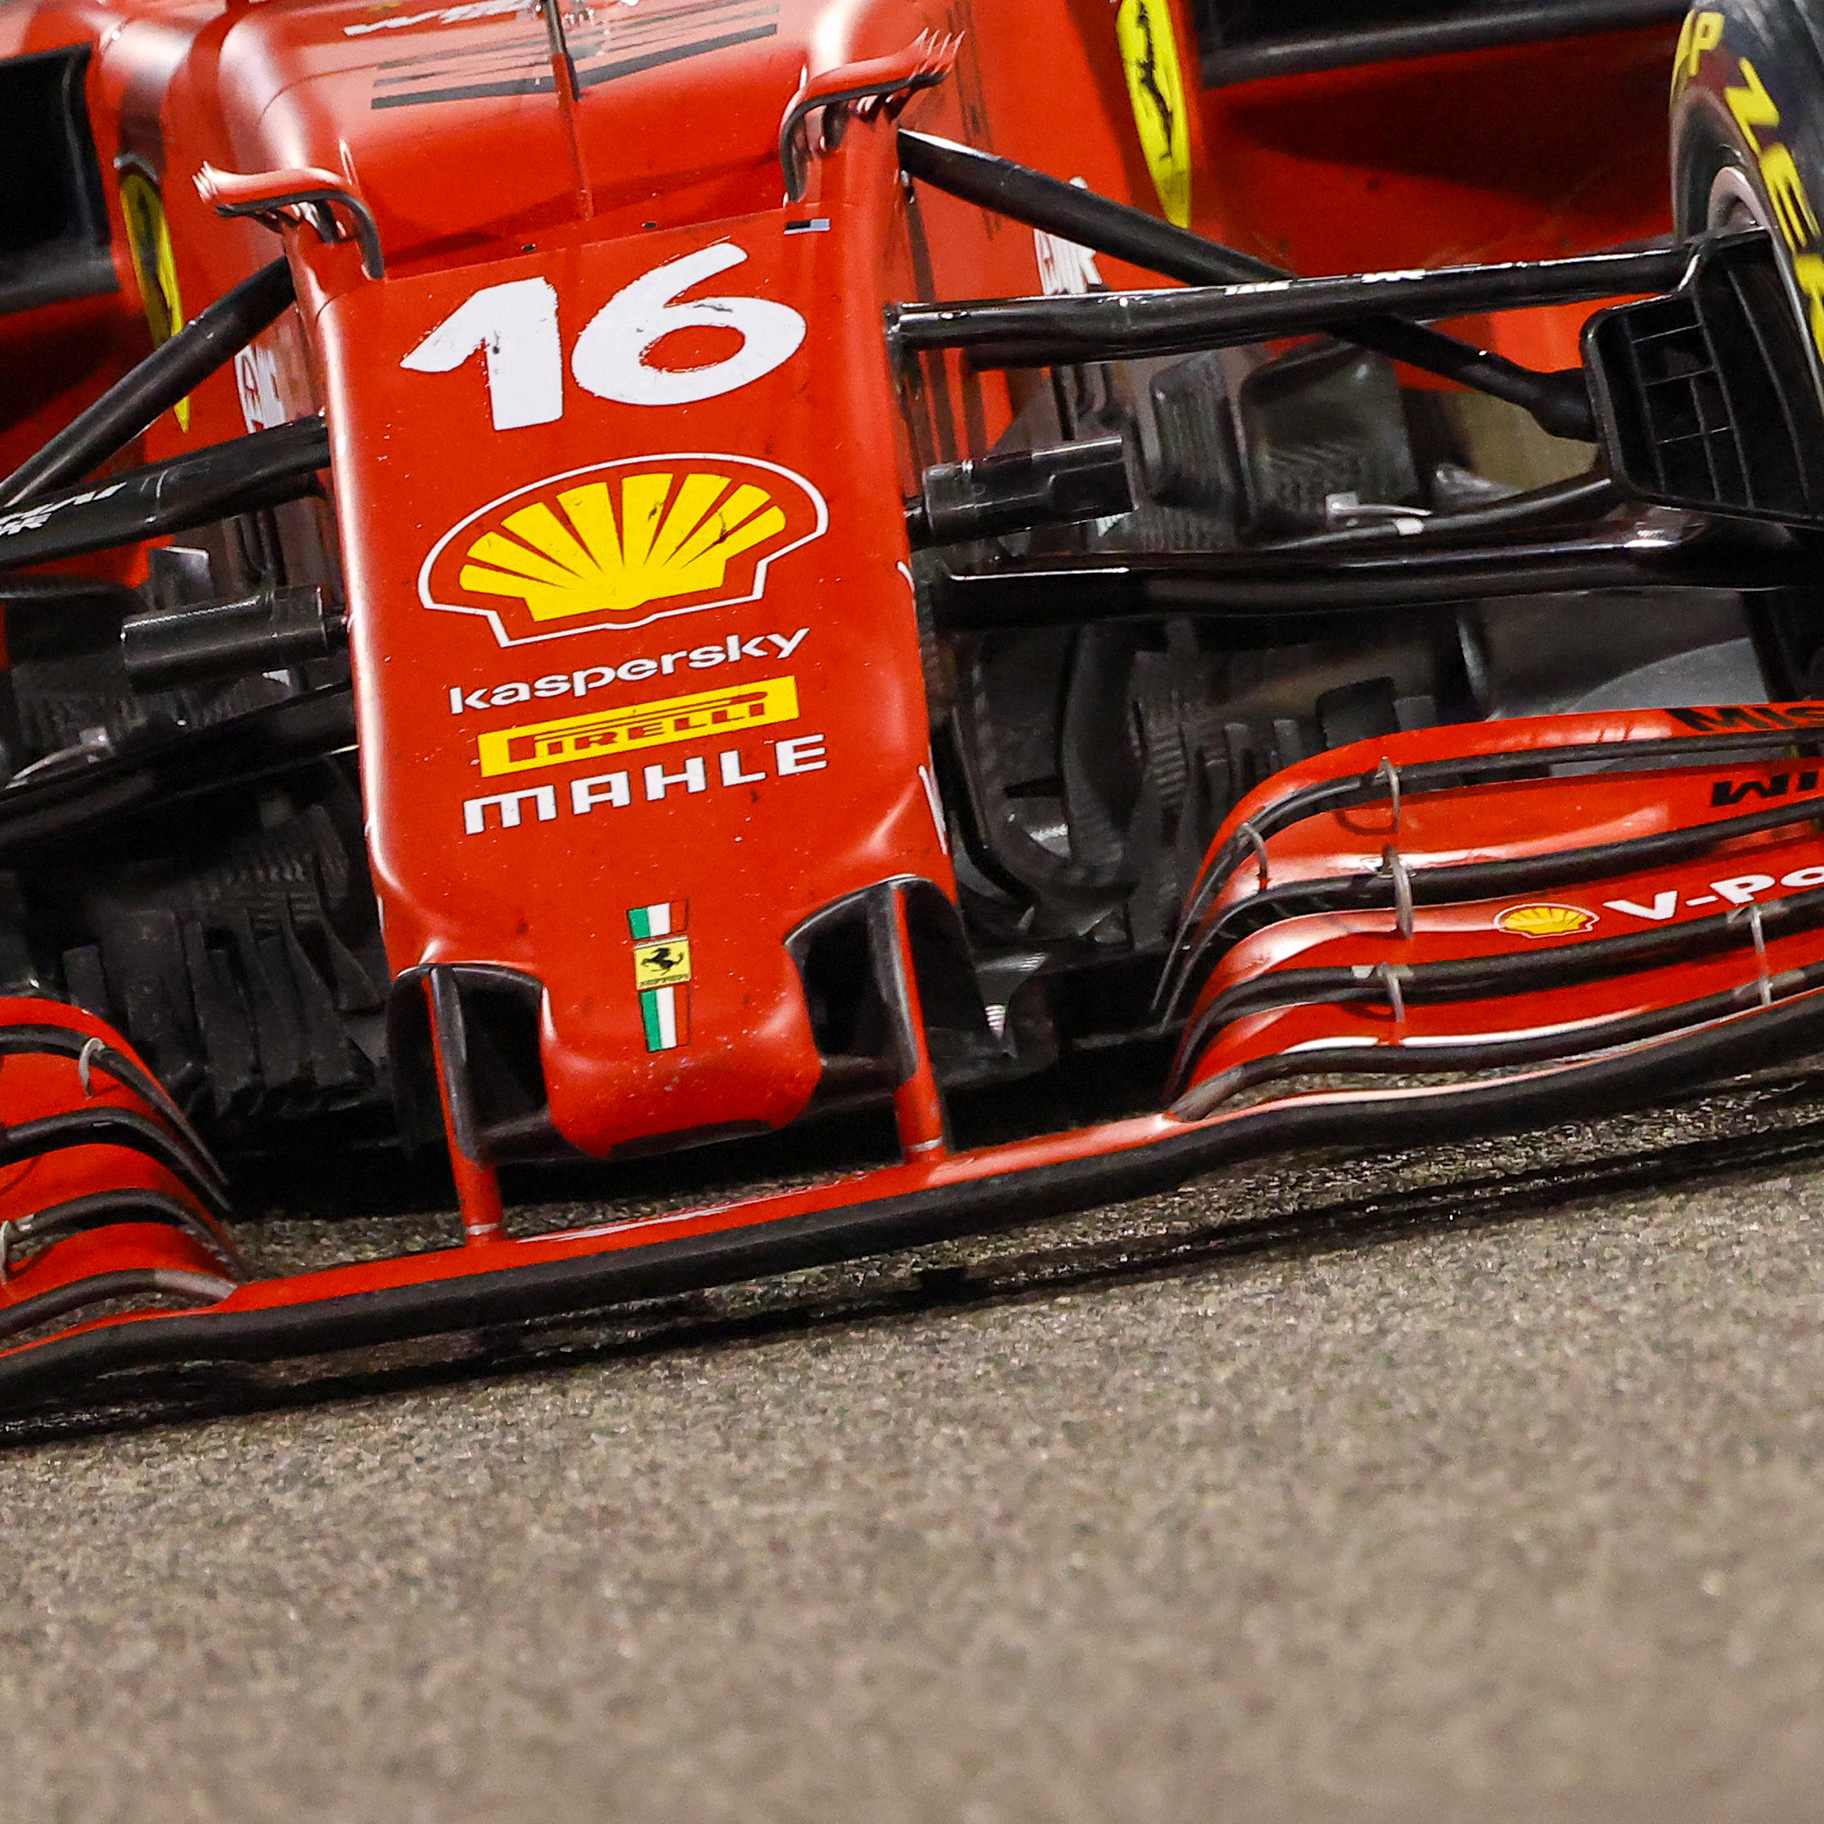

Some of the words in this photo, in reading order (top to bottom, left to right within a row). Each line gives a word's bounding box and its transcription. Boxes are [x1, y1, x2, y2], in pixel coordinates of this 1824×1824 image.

[398, 241, 807, 432] 16
[448, 627, 811, 715] kaspersky
[507, 690, 769, 764] PIRELLI
[462, 733, 828, 836] MAHLE
